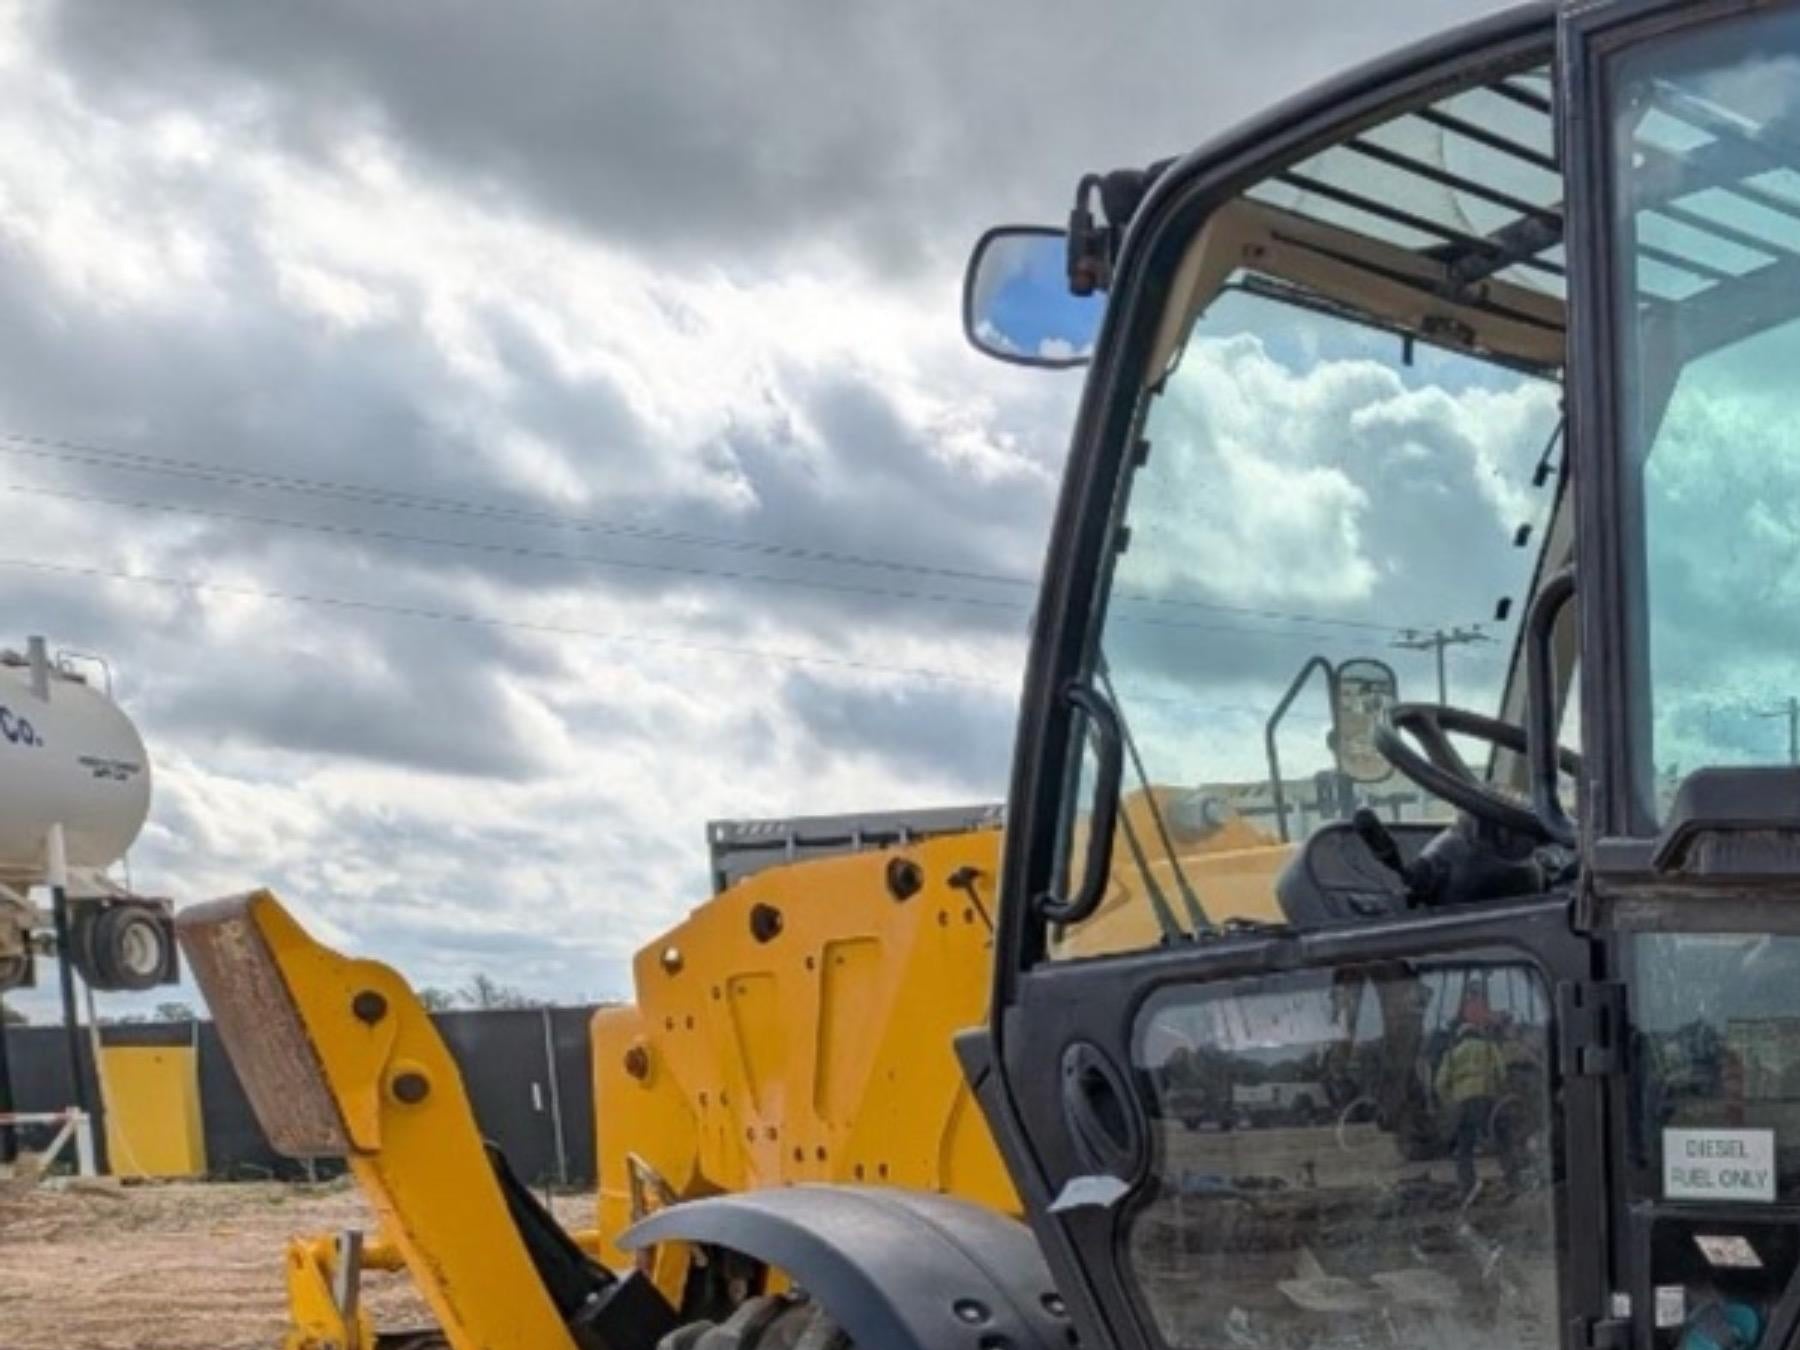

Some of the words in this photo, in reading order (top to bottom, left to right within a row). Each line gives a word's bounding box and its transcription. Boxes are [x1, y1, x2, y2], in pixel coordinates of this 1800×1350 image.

[1686, 1139, 1749, 1158] DIESEL
[1671, 1168, 1714, 1188] FUEL
[1718, 1168, 1768, 1189] ONLY
